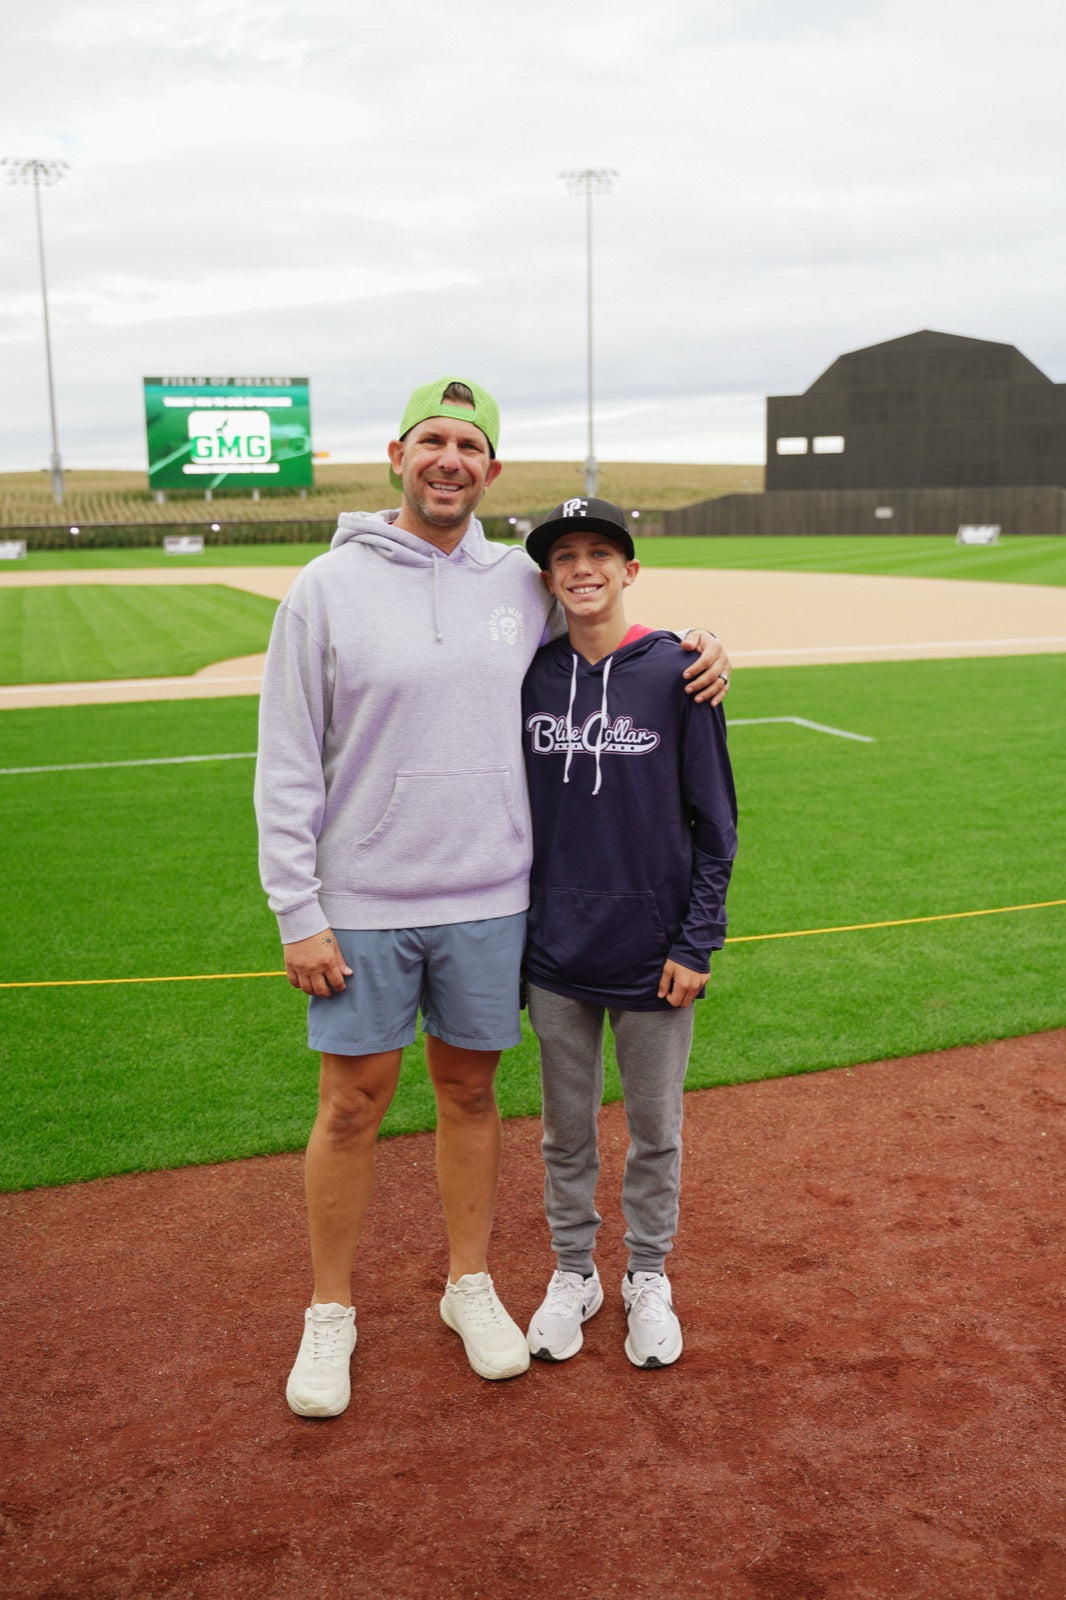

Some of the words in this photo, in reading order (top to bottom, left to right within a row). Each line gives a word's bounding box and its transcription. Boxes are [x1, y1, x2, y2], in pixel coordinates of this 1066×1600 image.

[191, 435, 266, 458] GMG
[527, 713, 582, 753] Blue
[582, 711, 659, 753] Collar
